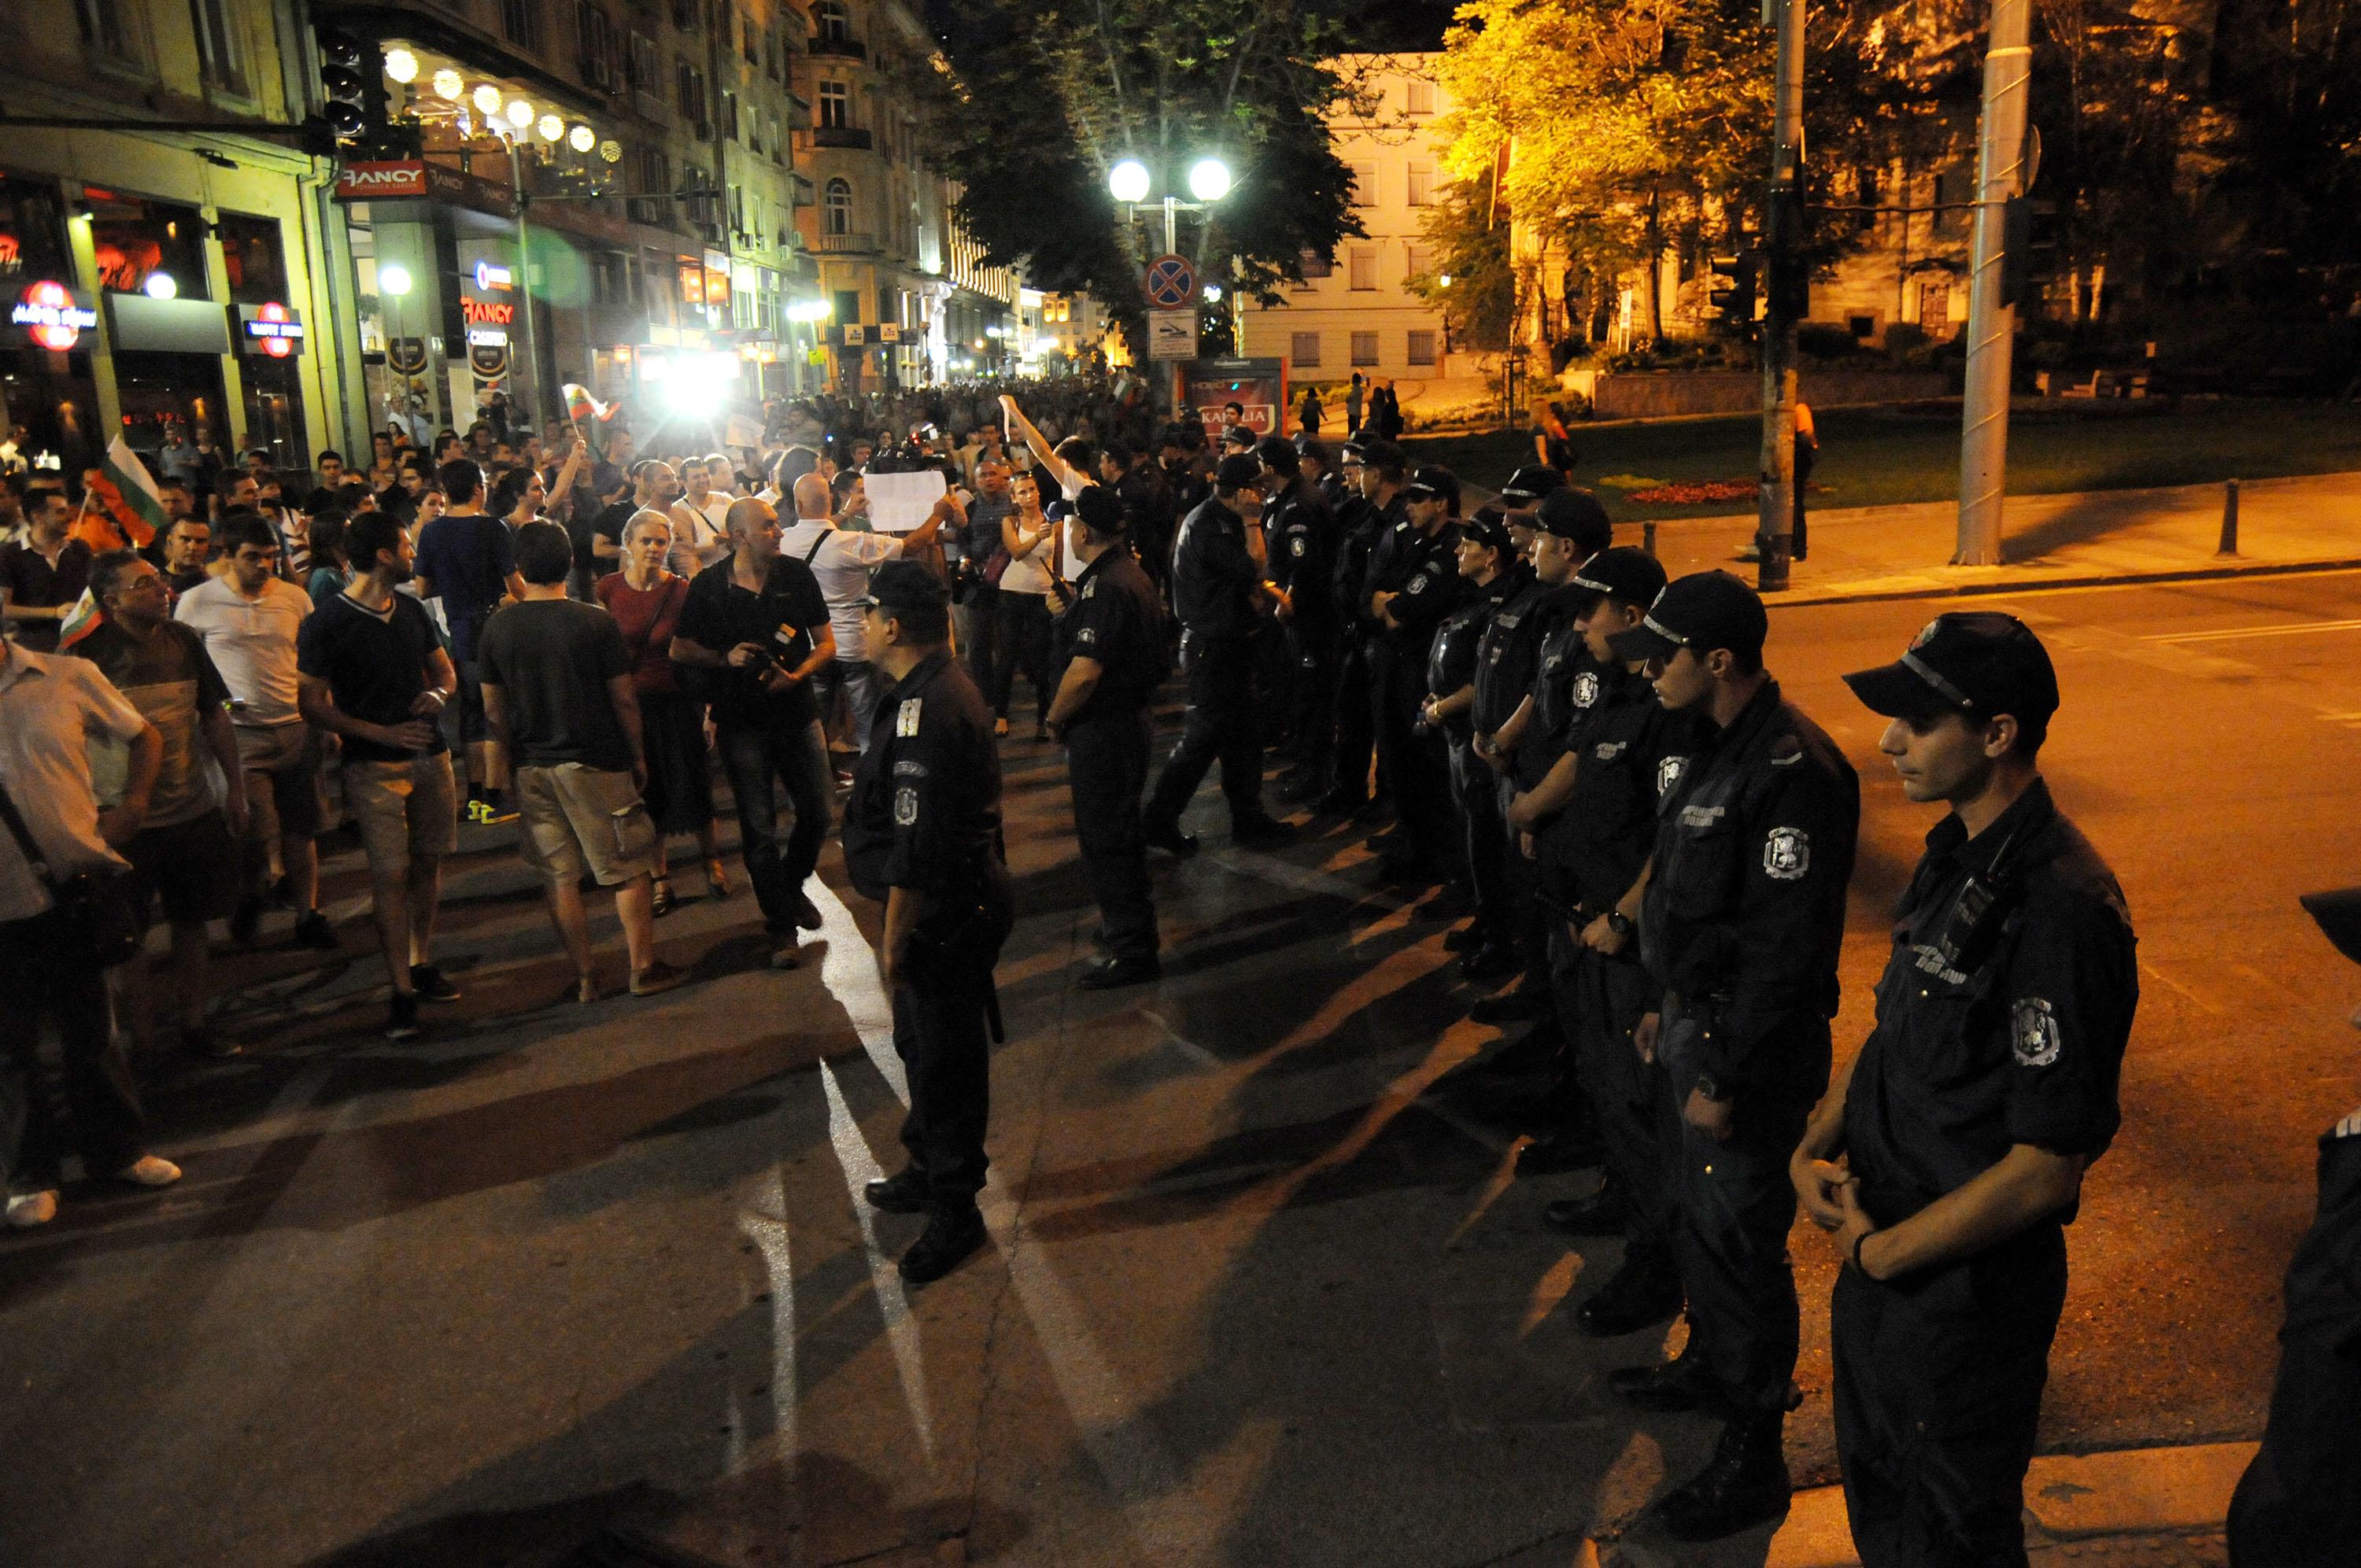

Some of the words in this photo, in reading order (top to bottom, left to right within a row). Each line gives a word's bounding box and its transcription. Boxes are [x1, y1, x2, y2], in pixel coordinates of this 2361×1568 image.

[343, 169, 423, 187] FANCY
[429, 169, 464, 190] FANCY
[460, 297, 513, 325] FANCY
[1201, 411, 1265, 423] KALIA
